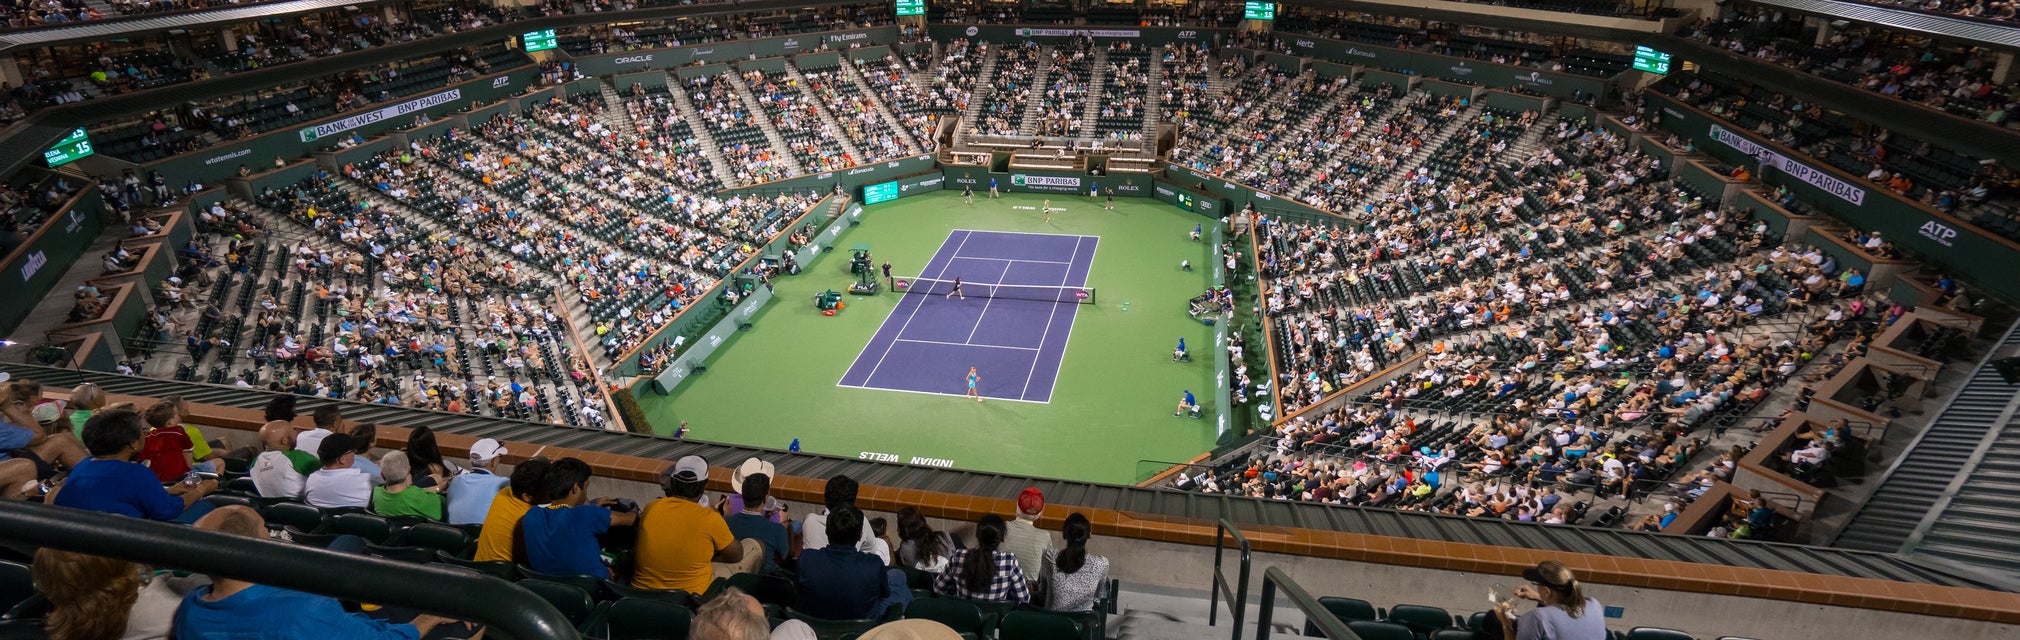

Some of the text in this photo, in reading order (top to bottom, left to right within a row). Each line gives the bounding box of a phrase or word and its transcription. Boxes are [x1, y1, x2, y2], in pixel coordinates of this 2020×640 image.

[547, 38, 557, 46] 15
[1296, 39, 1315, 48] Hertz
[614, 54, 653, 64] ORACLE
[1656, 62, 1668, 72] 15
[493, 76, 509, 86] ATP
[397, 90, 459, 114] BNP PARIBAS
[317, 120, 348, 136] BANK
[355, 110, 384, 125] WEST
[1720, 130, 1743, 149] BANK
[75, 140, 90, 154] 15
[205, 149, 251, 165] wtatennis.com
[1045, 178, 1078, 186] PARIBAS
[1190, 170, 1210, 180] ORACLE
[1784, 160, 1861, 203] BNP PARIBAS
[1919, 220, 1957, 239] ATP
[859, 451, 954, 468] INDIAN WELLS
